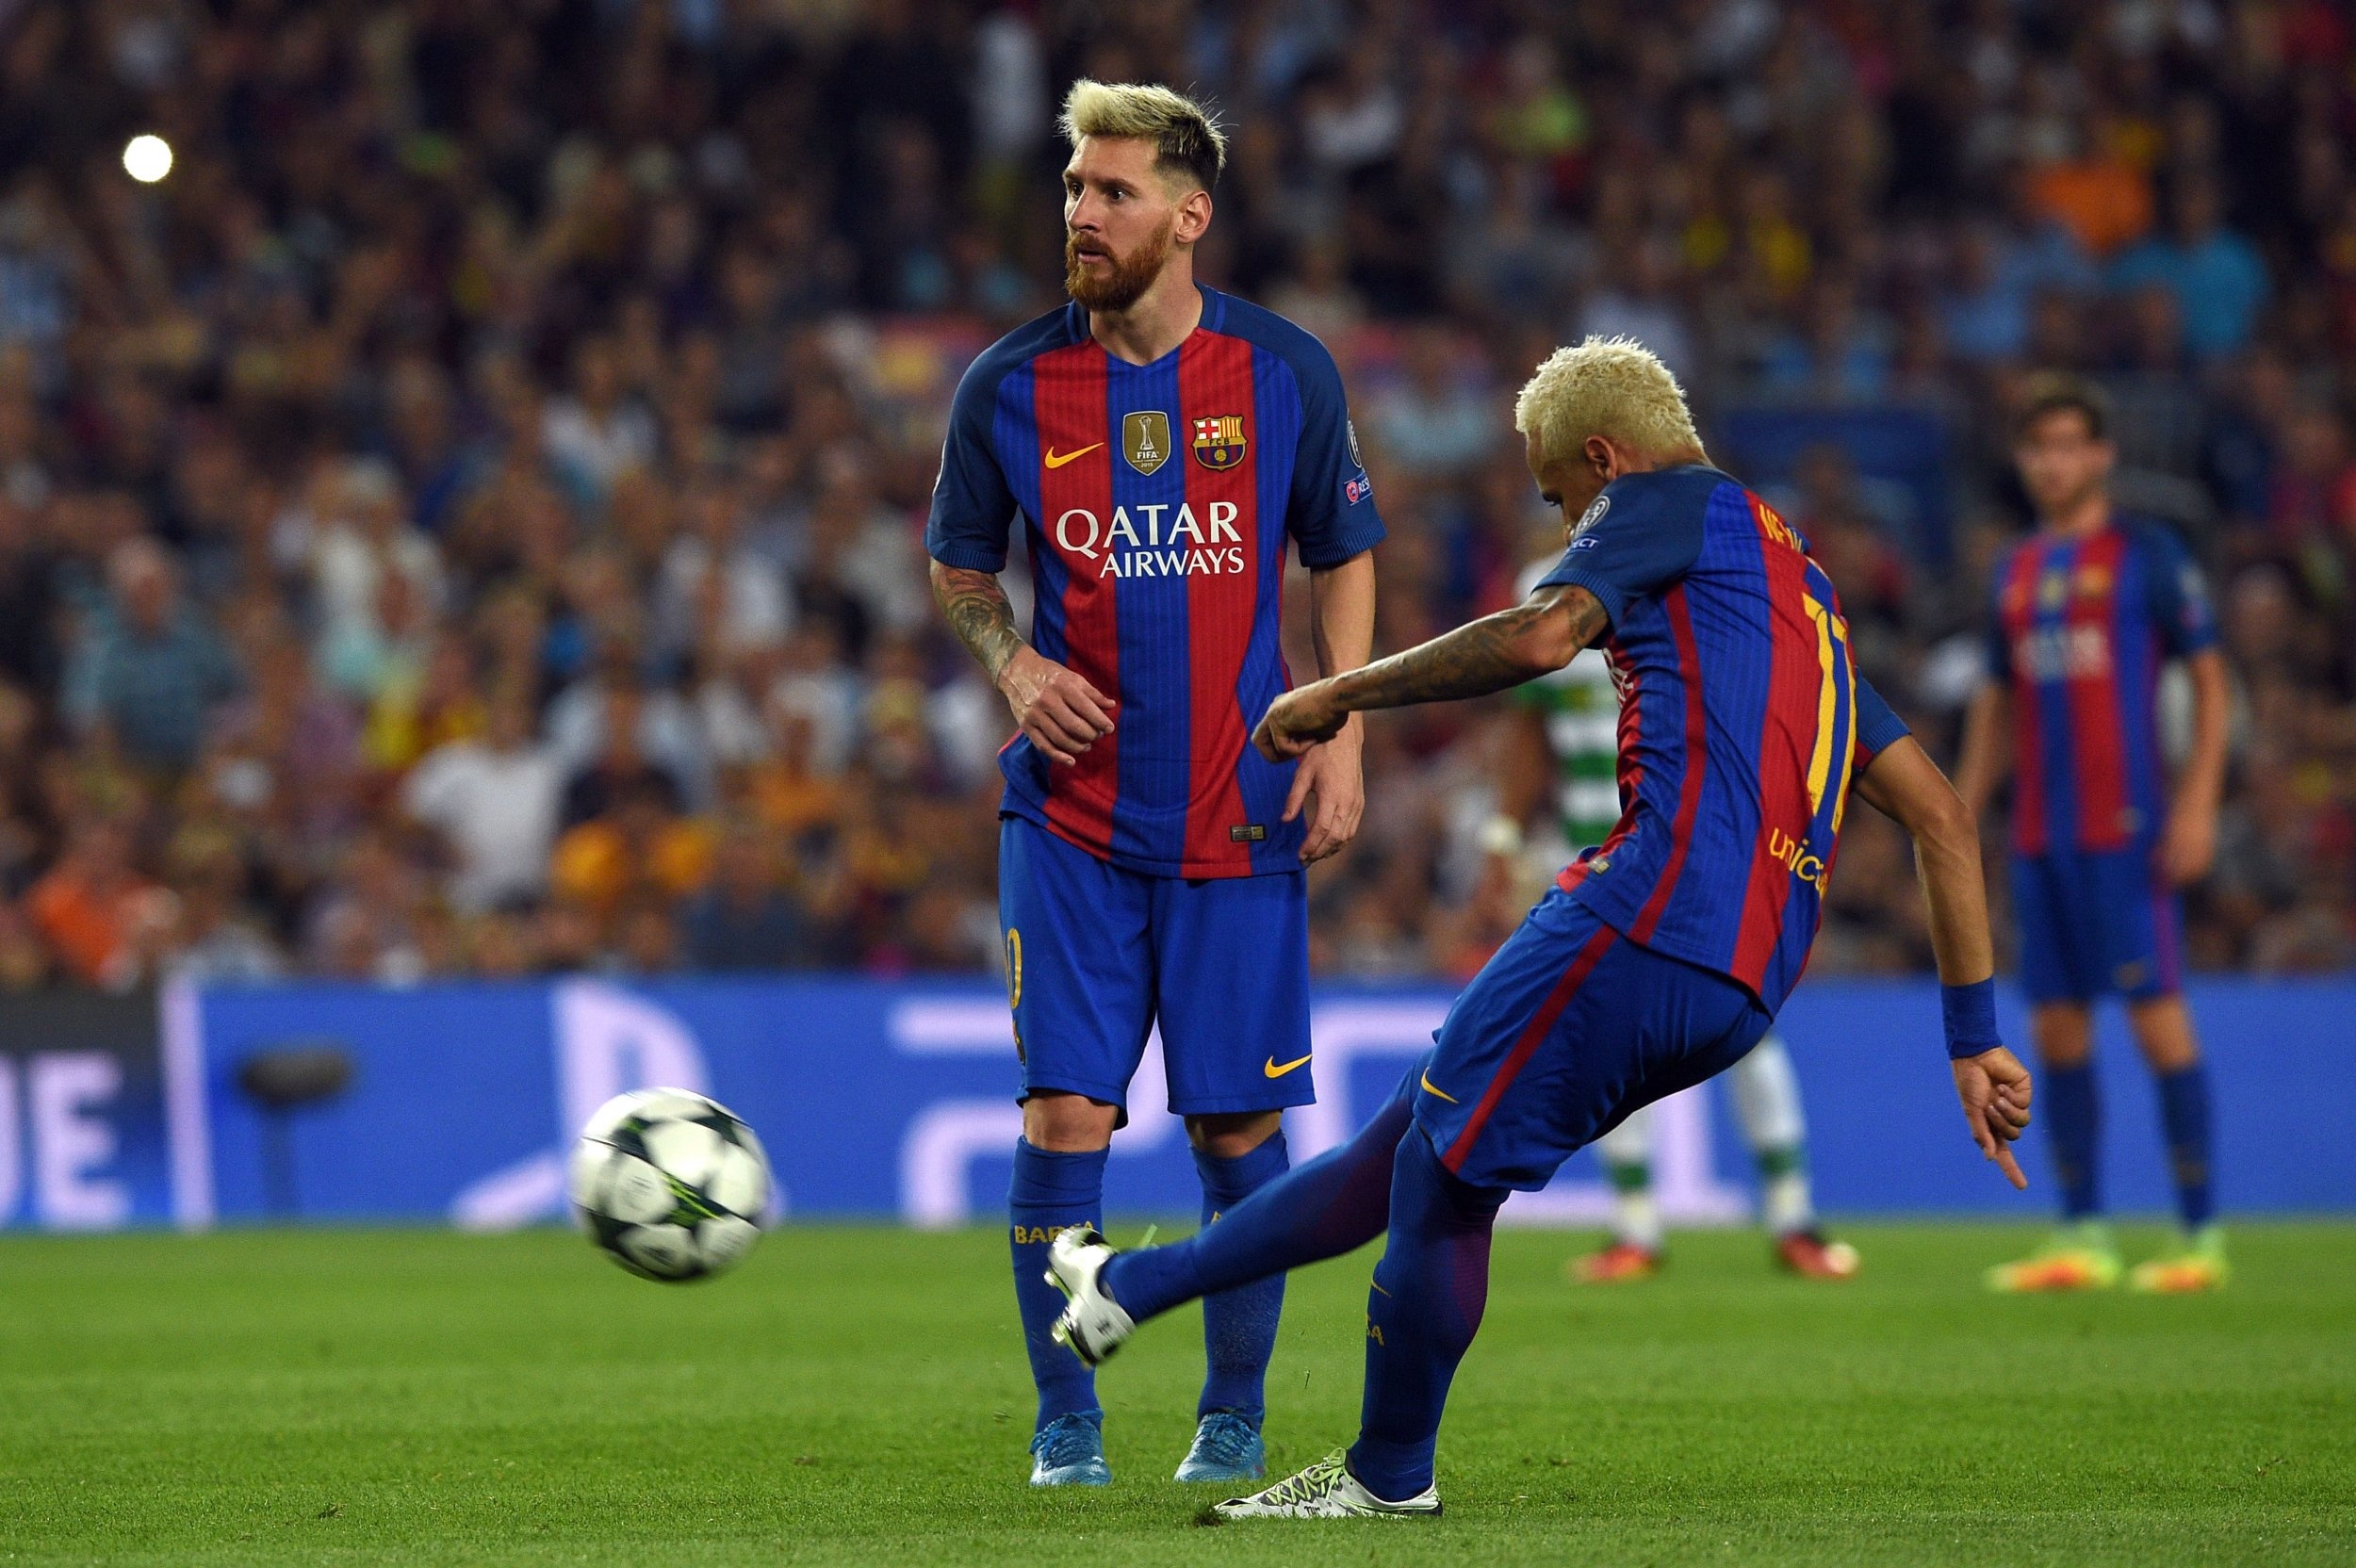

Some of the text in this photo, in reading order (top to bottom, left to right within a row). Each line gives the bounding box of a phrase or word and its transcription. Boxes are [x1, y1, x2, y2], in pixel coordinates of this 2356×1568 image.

[1137, 450, 1158, 460] FIFA
[1055, 501, 1243, 560] QATAR
[1099, 547, 1245, 579] AIRWAYS
